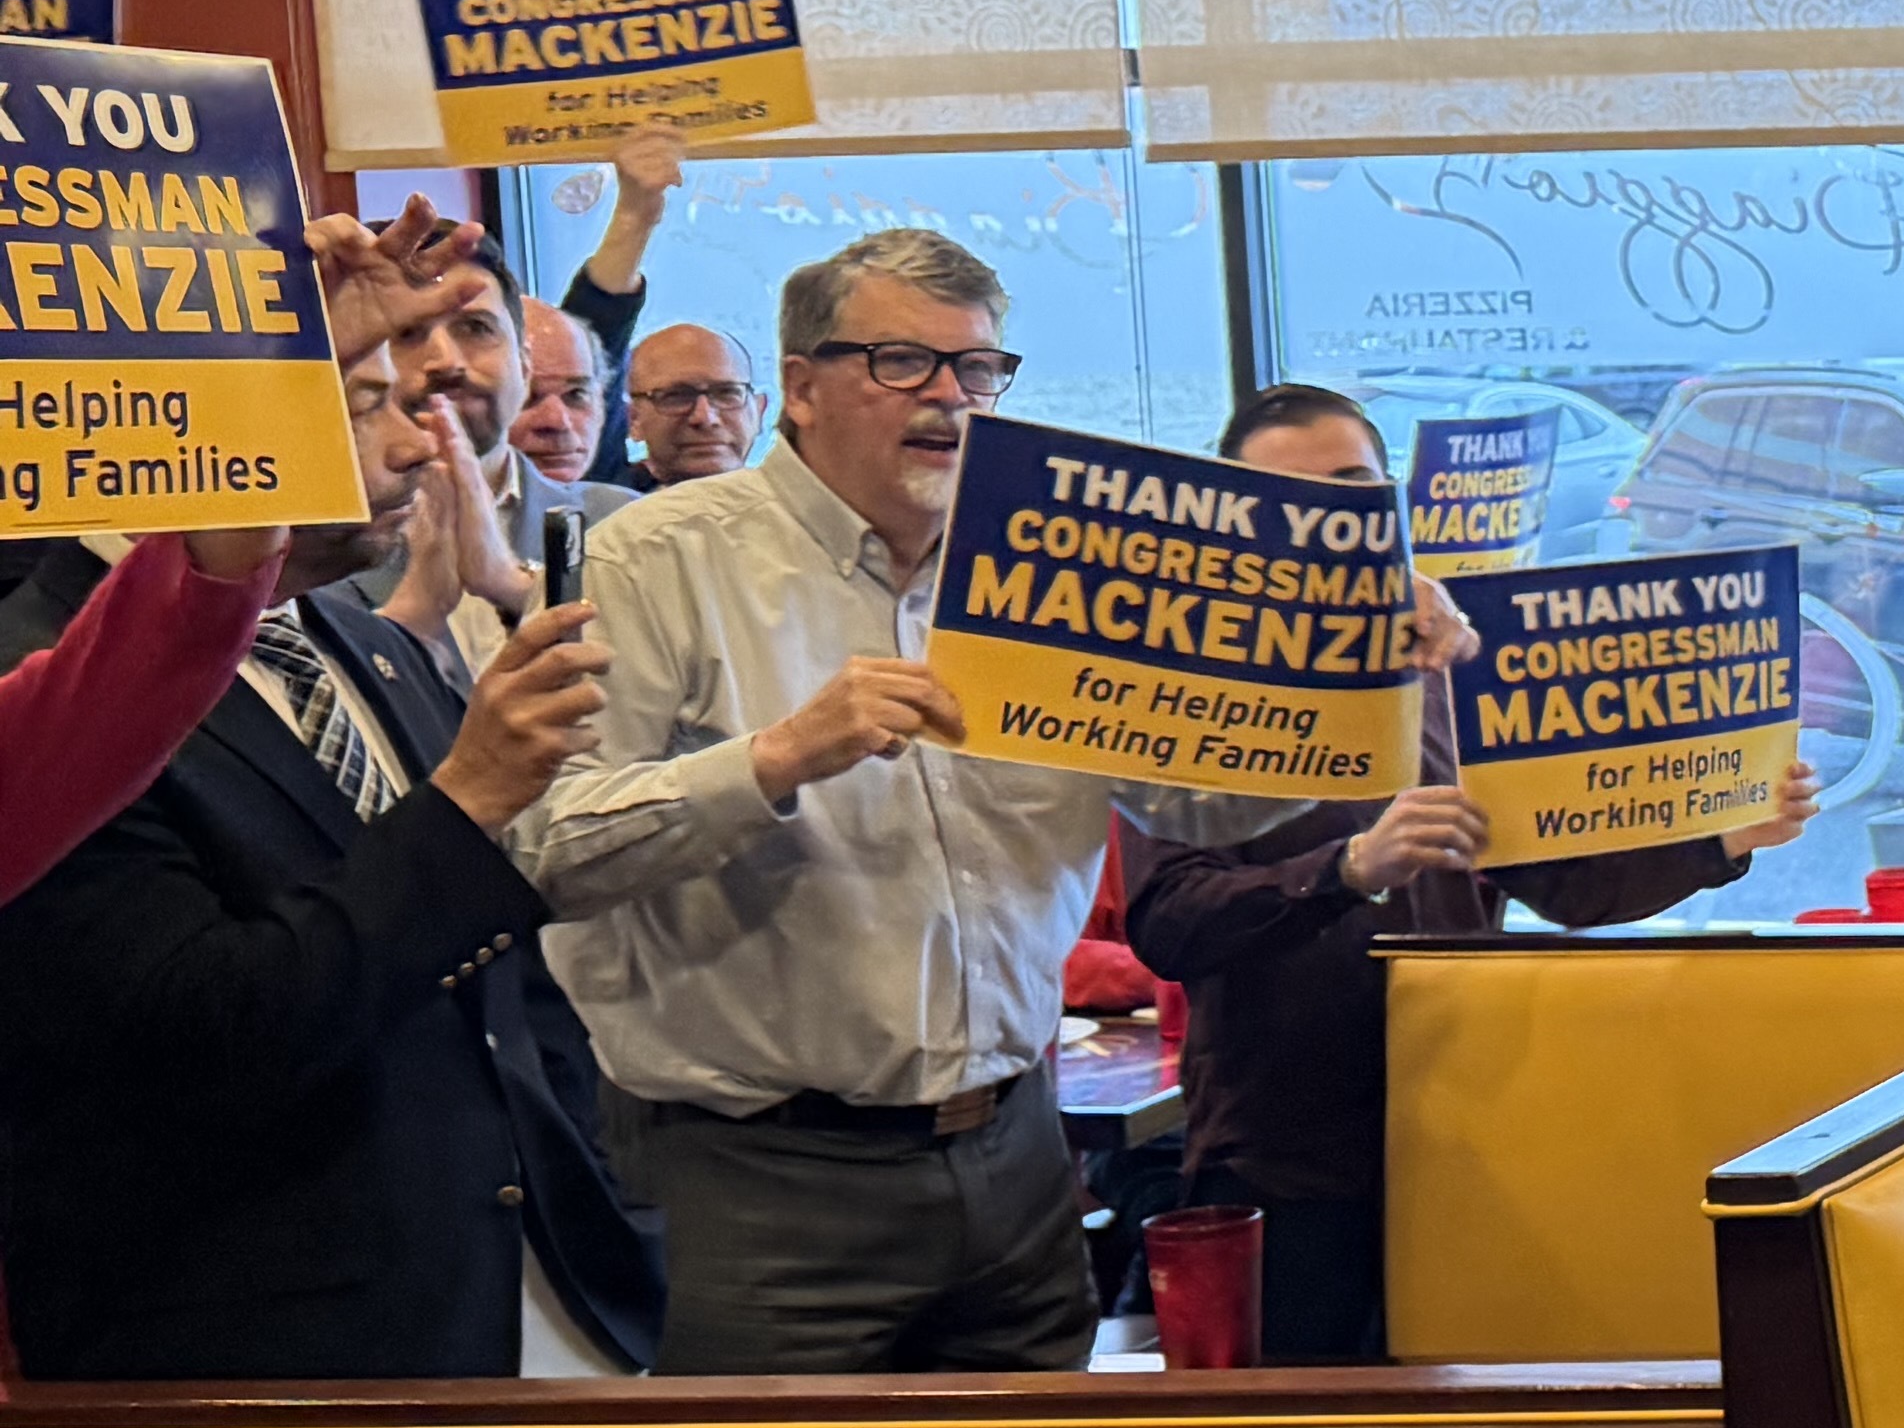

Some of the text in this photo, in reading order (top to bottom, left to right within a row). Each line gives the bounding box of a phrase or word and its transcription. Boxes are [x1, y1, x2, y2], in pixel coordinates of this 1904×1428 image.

[36, 83, 197, 154] YOU
[0, 240, 301, 334] ENZIE
[64, 444, 280, 499] Families
[1045, 455, 1396, 553] THANK YOU
[1006, 508, 1407, 607] CONGRESSMAN
[965, 554, 1416, 673] MACKENZIE
[1511, 570, 1766, 632] THANK YOU
[1495, 616, 1780, 684] CONGRESSMAN
[1070, 668, 1320, 740] for Helping
[1476, 656, 1794, 748] MACKENZIE
[999, 700, 1373, 779] Working Families
[1587, 746, 1742, 793] for Helping
[1534, 778, 1769, 839] Working Families
